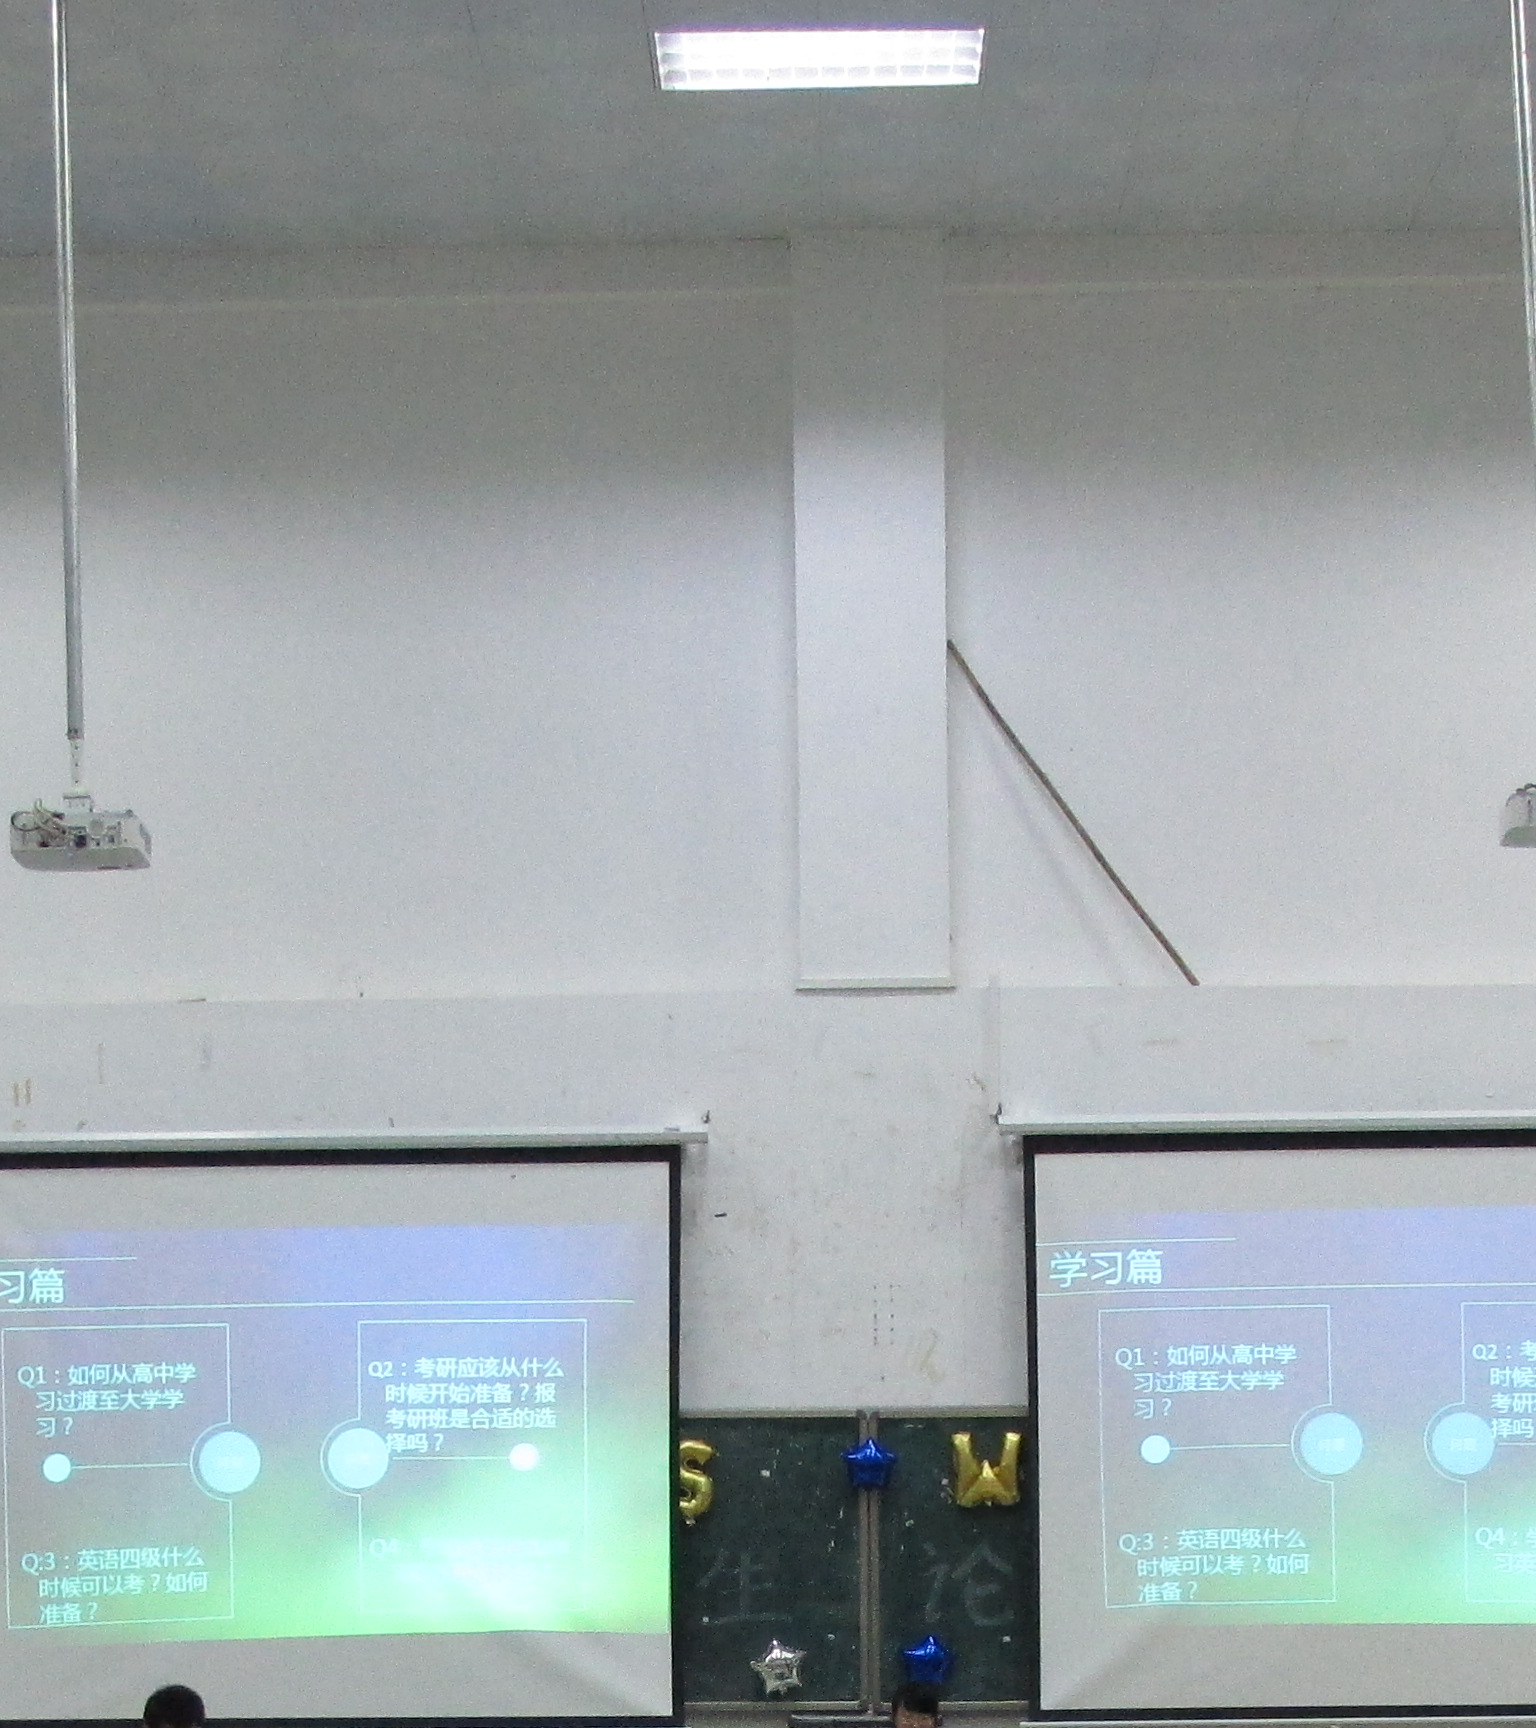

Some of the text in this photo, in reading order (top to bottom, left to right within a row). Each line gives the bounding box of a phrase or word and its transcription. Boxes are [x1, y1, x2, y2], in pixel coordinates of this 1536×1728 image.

[1049, 1249, 1163, 1288] 学习篇
[1134, 1370, 1284, 1393] 习过渡至大学学
[35, 1390, 185, 1412] 习过渡至大学学
[385, 1408, 556, 1429] 考研班是合适的选
